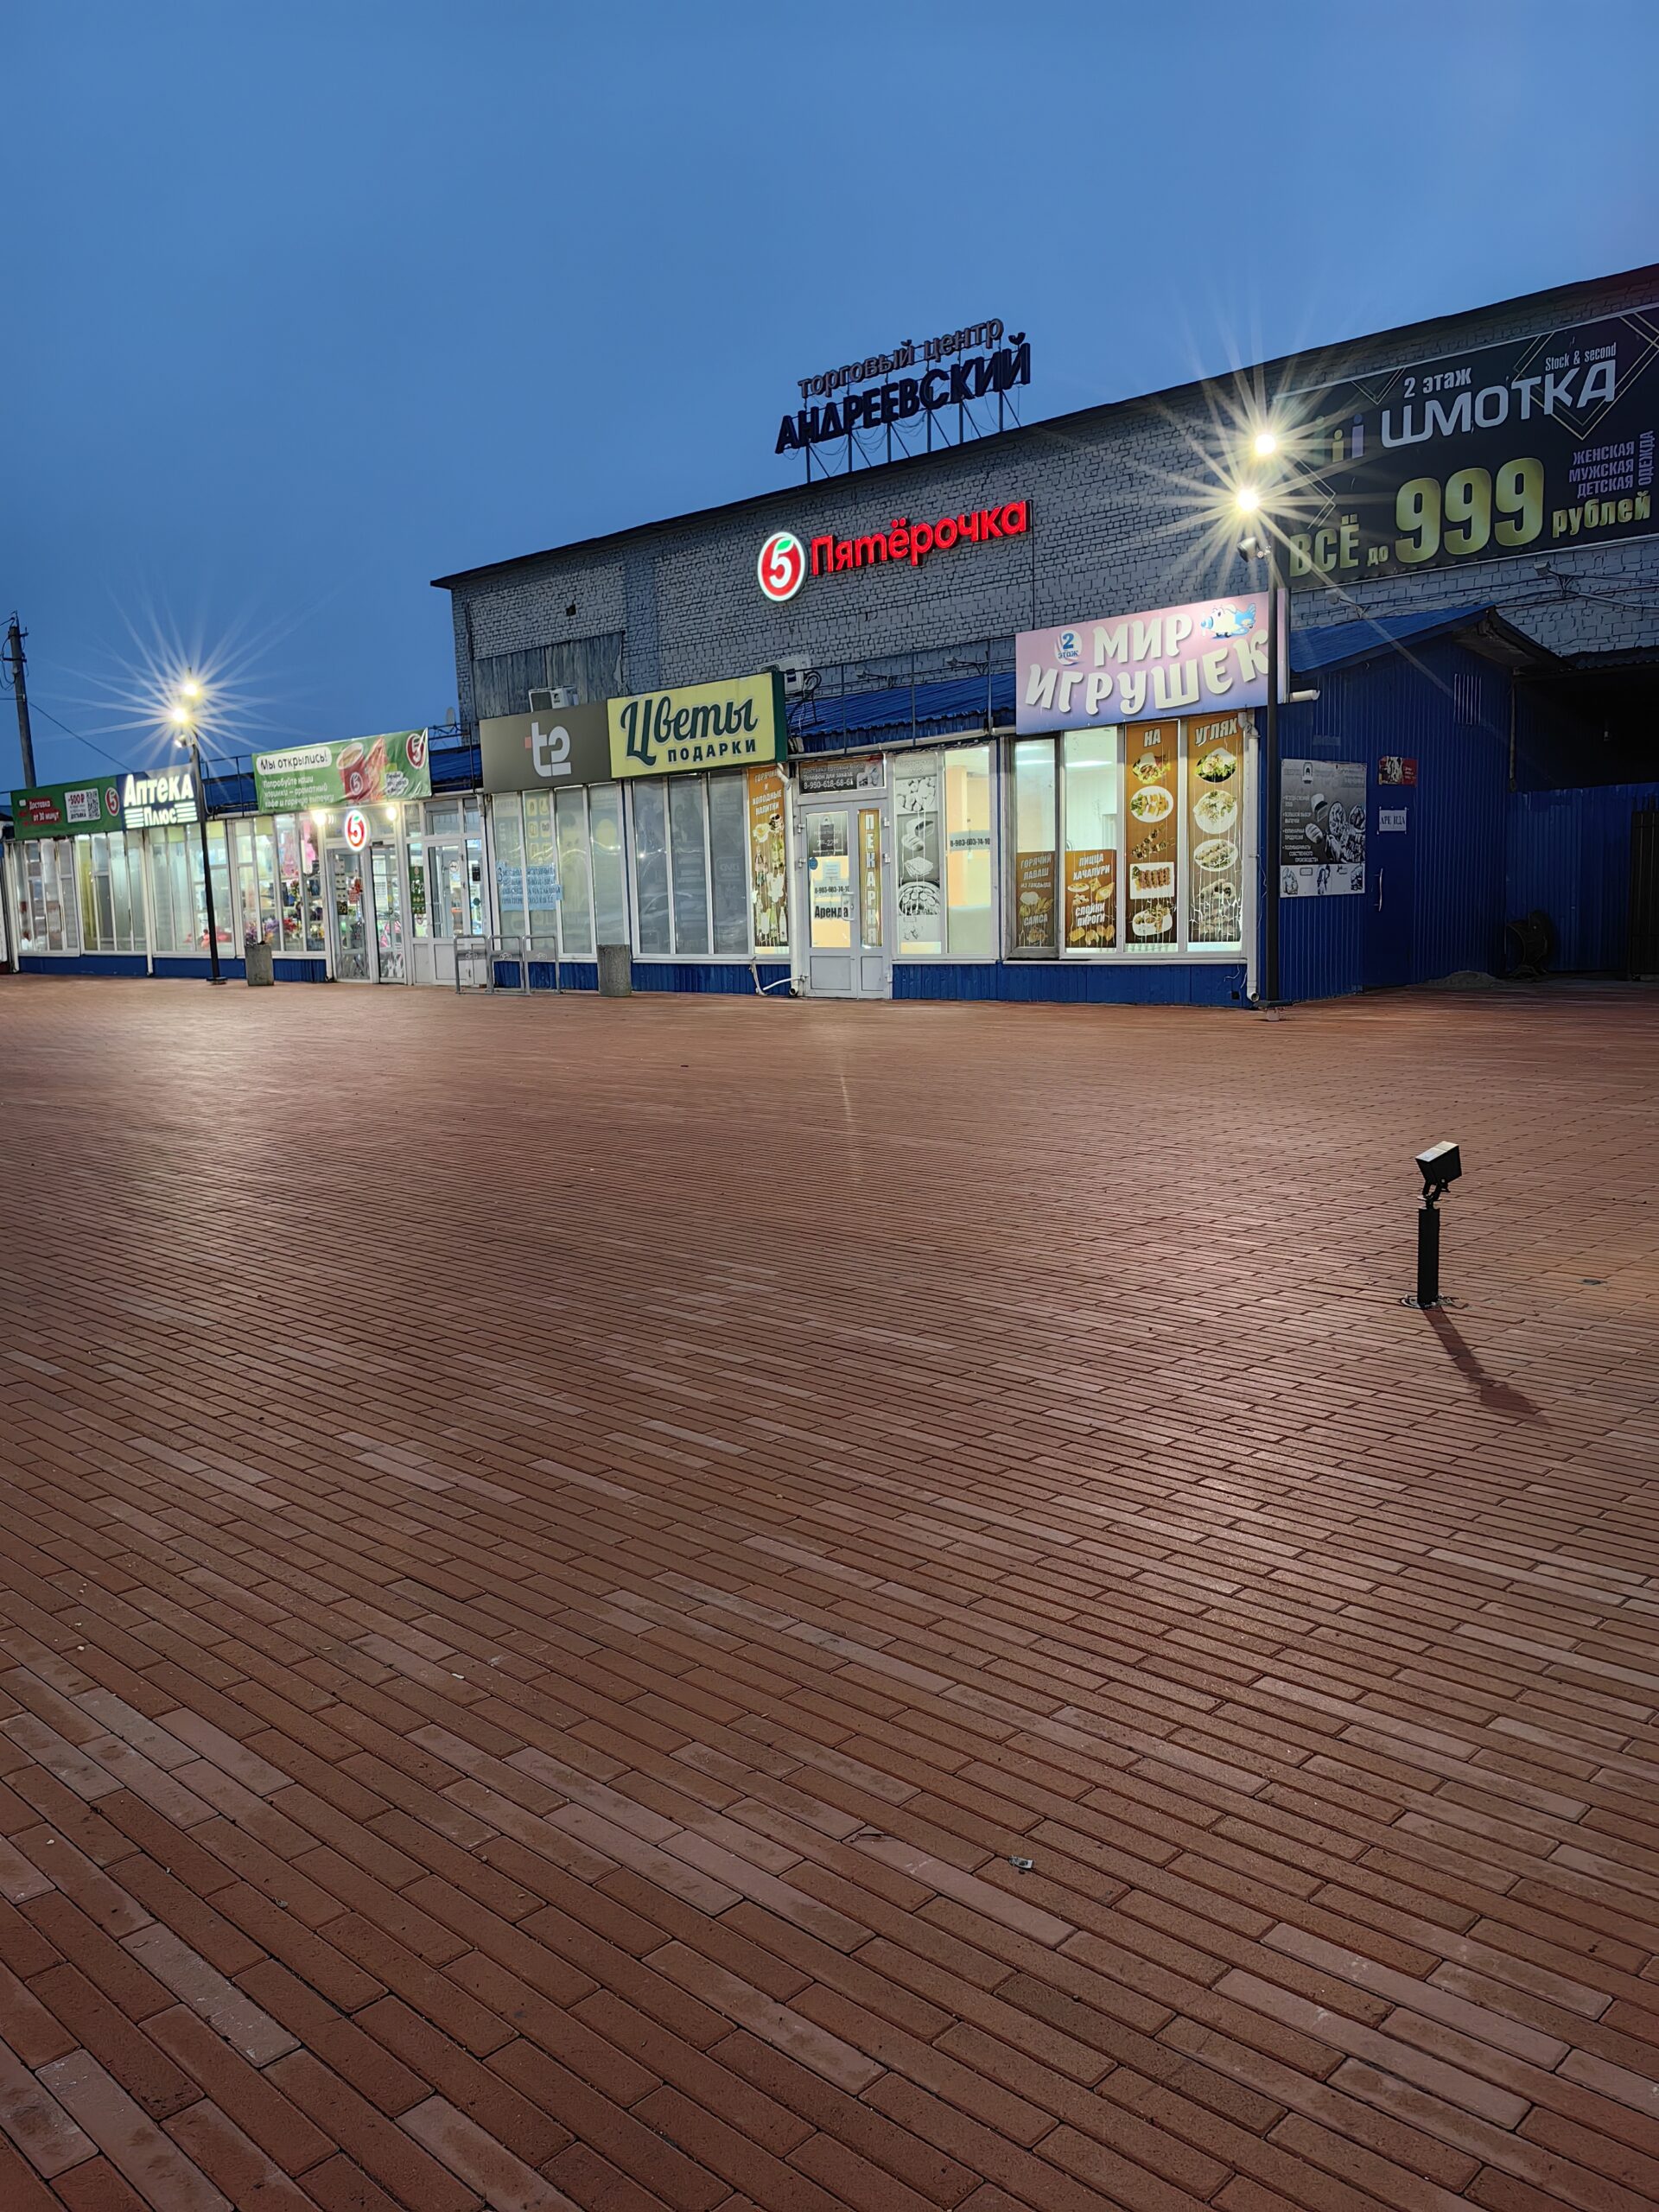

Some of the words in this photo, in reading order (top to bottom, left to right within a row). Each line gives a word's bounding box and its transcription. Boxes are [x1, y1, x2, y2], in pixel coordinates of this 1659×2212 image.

[797, 339, 915, 399] торговый
[923, 318, 1005, 364] центр
[1545, 353, 1569, 372] Stock
[1584, 341, 1617, 362] second
[774, 332, 1031, 454] АНДРЕЕВСКИЙ
[1403, 376, 1416, 399] 2
[1422, 366, 1472, 396] этаж
[1380, 359, 1617, 449] ШМОТКА
[1573, 441, 1635, 466] ЖЕНСКАЯ
[1637, 429, 1656, 487] ОДЕЖДА
[1568, 458, 1634, 484] МУЖСКАЯ
[1577, 474, 1634, 499] ДЕТСКАЯ
[1289, 513, 1360, 578] ВСЁ
[1367, 544, 1389, 567] до
[1395, 457, 1545, 563] 999
[1552, 490, 1651, 538] рублей
[810, 499, 1031, 576] Пятёрочка
[1062, 632, 1075, 650] 2
[1093, 613, 1193, 667] МИР
[1058, 650, 1079, 659] этаж
[1025, 630, 1268, 715] ИГРУШЕК
[620, 695, 760, 766] Цветы
[1143, 728, 1161, 747] НА
[1195, 718, 1237, 744] УГЛЯХ
[260, 758, 276, 771] Мы
[277, 749, 327, 769] открылись!
[667, 741, 757, 763] ПОДАРКИ
[263, 777, 297, 788] Попробуйте
[753, 789, 782, 805] ХОЛОДНЫЕ
[755, 801, 779, 816] НАПИТКИ
[1020, 854, 1052, 869] ГОРЯЧИЙ
[1073, 864, 1110, 880] ХАЧАПУРИ
[1078, 854, 1104, 867] ПИЦЦА
[865, 814, 876, 945] ПЕКАРНЯ
[814, 906, 849, 919] Аренда
[1075, 902, 1106, 916] СЛОЙКИ
[1077, 913, 1105, 927] ПИРОГИ
